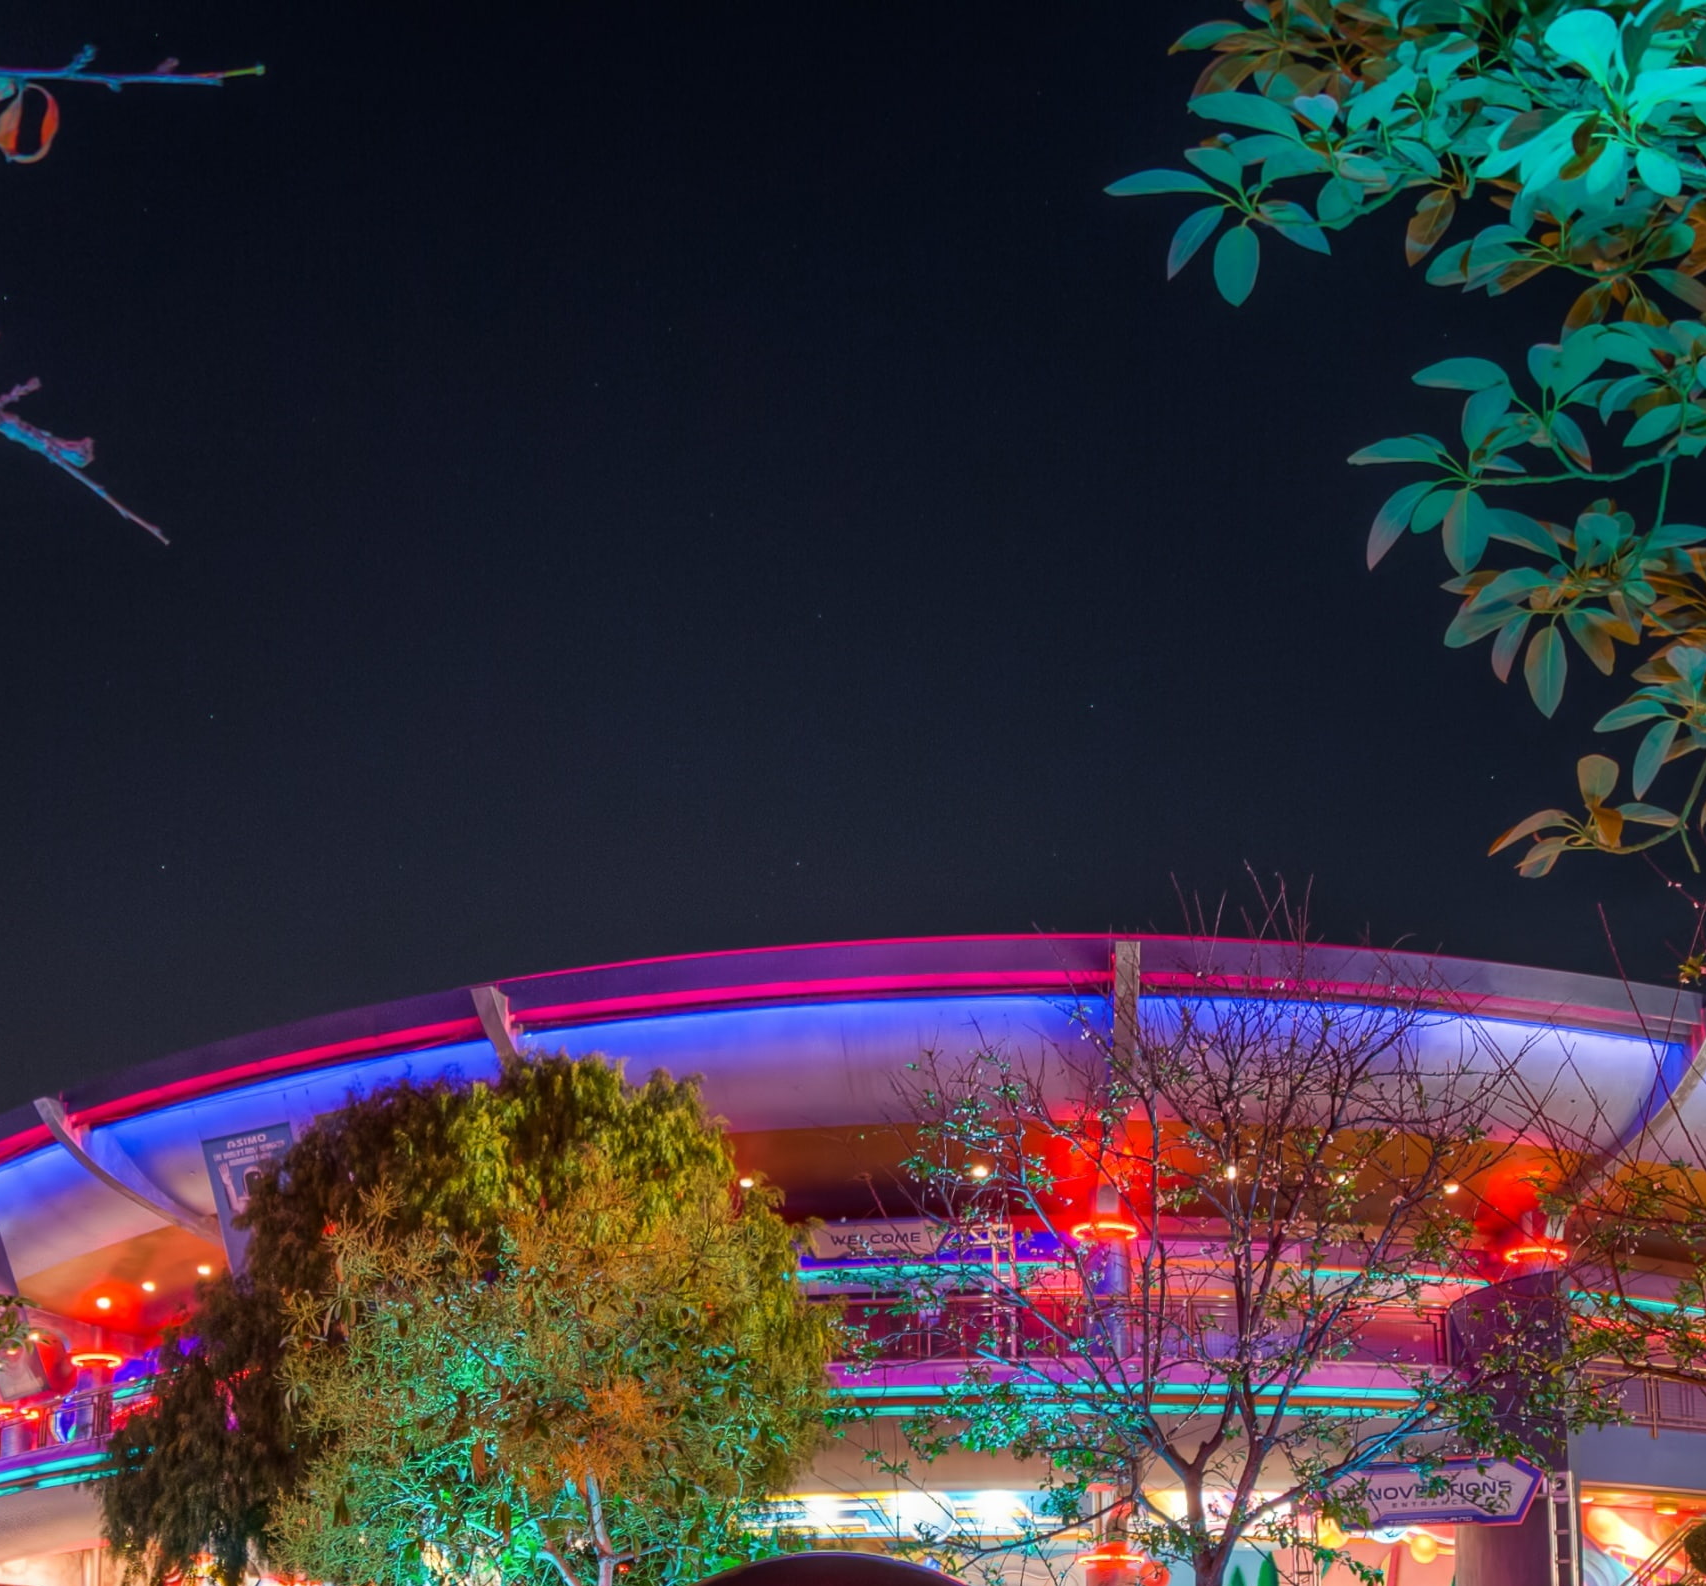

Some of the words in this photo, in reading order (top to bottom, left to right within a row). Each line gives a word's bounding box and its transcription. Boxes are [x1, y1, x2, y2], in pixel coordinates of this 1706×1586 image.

[227, 1134, 267, 1149] ASIMO
[1349, 1480, 1512, 1501] NOVETIONS
[1391, 1498, 1467, 1509] ENTRANCE
